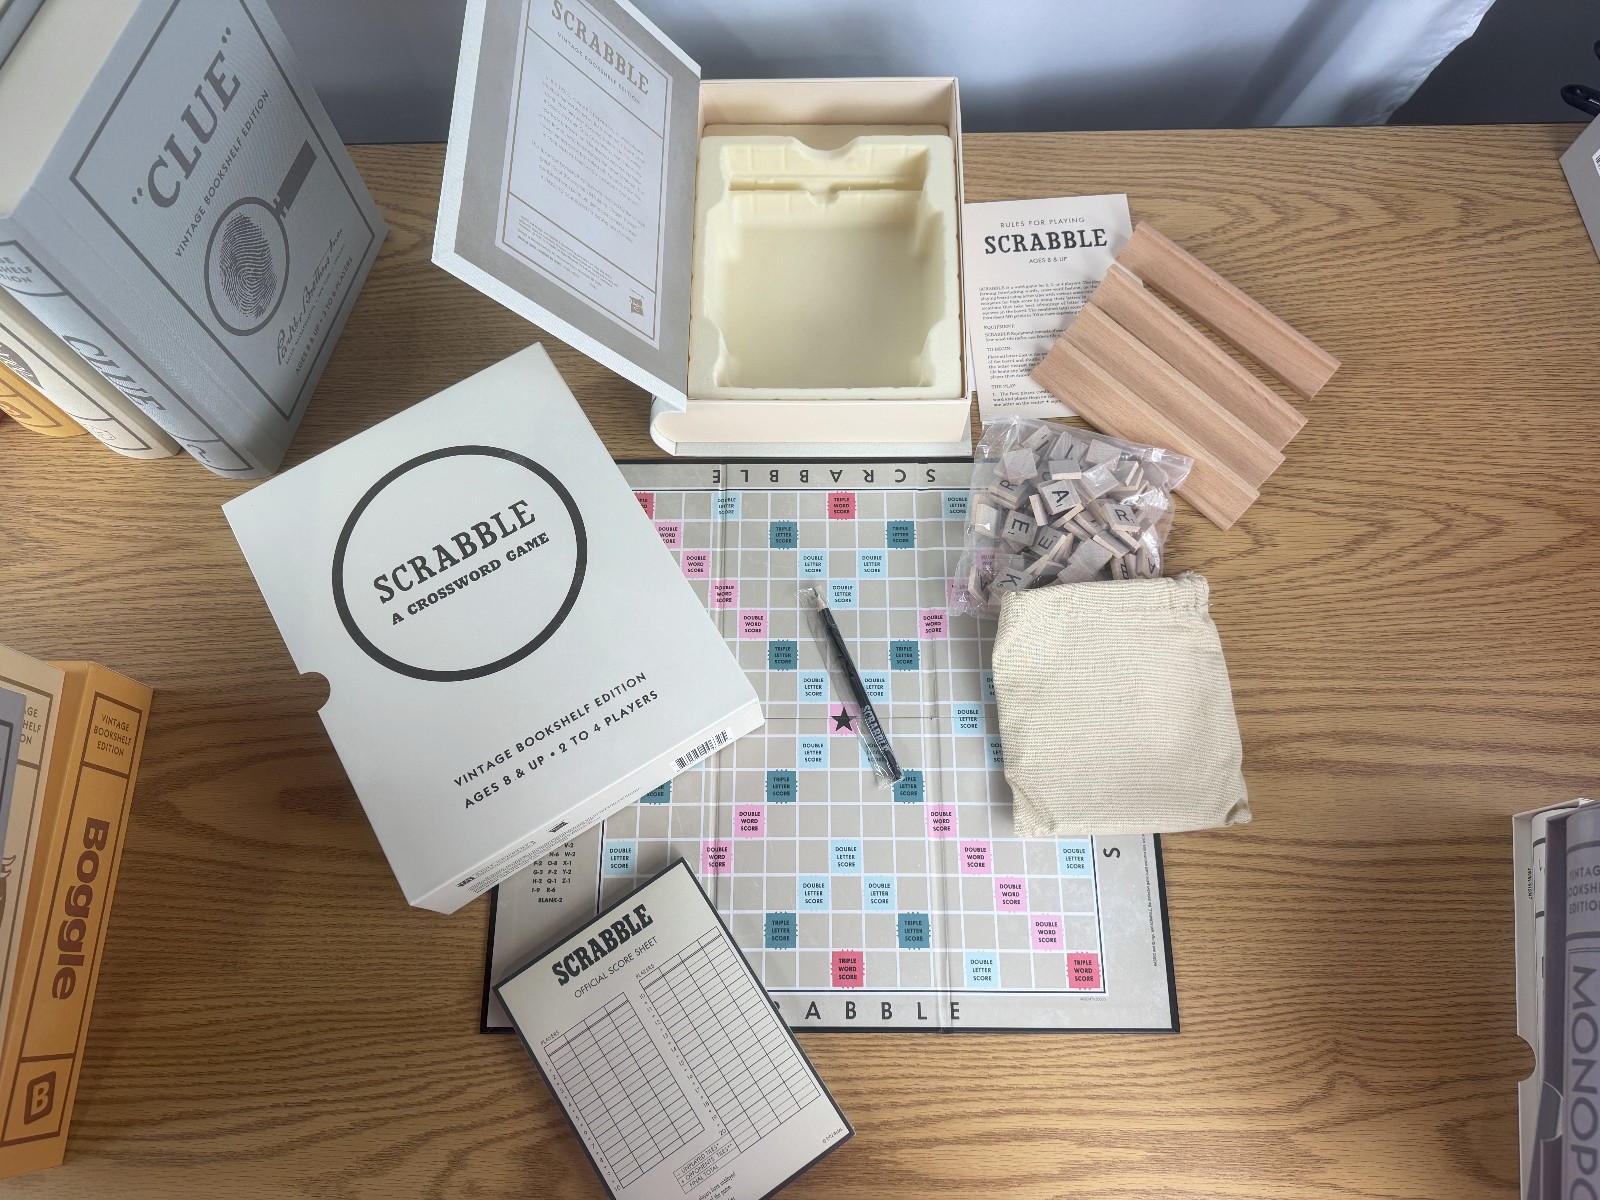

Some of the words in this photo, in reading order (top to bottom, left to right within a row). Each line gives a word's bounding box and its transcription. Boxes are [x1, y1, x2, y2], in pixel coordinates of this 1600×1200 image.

[552, 0, 649, 95] SCRABBLE
[174, 205, 206, 258] VINTAGE
[203, 136, 242, 205] BOOKSHELF
[241, 89, 269, 138] EDITION
[984, 228, 1108, 254] SCRABBLE
[373, 499, 536, 604] SCRABBLE
[391, 612, 404, 625] A
[407, 558, 502, 616] CROSSWORD
[506, 533, 550, 562] GAME
[94, 726, 132, 746] BOOKSHELF
[97, 740, 124, 756] EDITION
[102, 714, 130, 732] VINTAGE
[453, 748, 514, 786] VINTAGE
[515, 702, 592, 752] BOOKSHELF
[595, 672, 647, 706] EDITION
[464, 779, 500, 809] AGES
[502, 774, 512, 787] 8
[514, 767, 526, 780] &
[528, 756, 546, 773] UP
[559, 741, 568, 756] 2
[570, 730, 589, 749] TO
[592, 723, 602, 735] 4
[604, 690, 659, 727] PLAYERS
[863, 704, 892, 752] SCRABBLE
[52, 816, 110, 1001] Boggle
[1570, 865, 1600, 880] VINTAG
[552, 904, 653, 986] SCRABBLE
[574, 973, 609, 998] OFFICIAL
[608, 954, 634, 975] SCORE
[635, 936, 658, 956] SHEET
[772, 1000, 960, 1020] ABBLE
